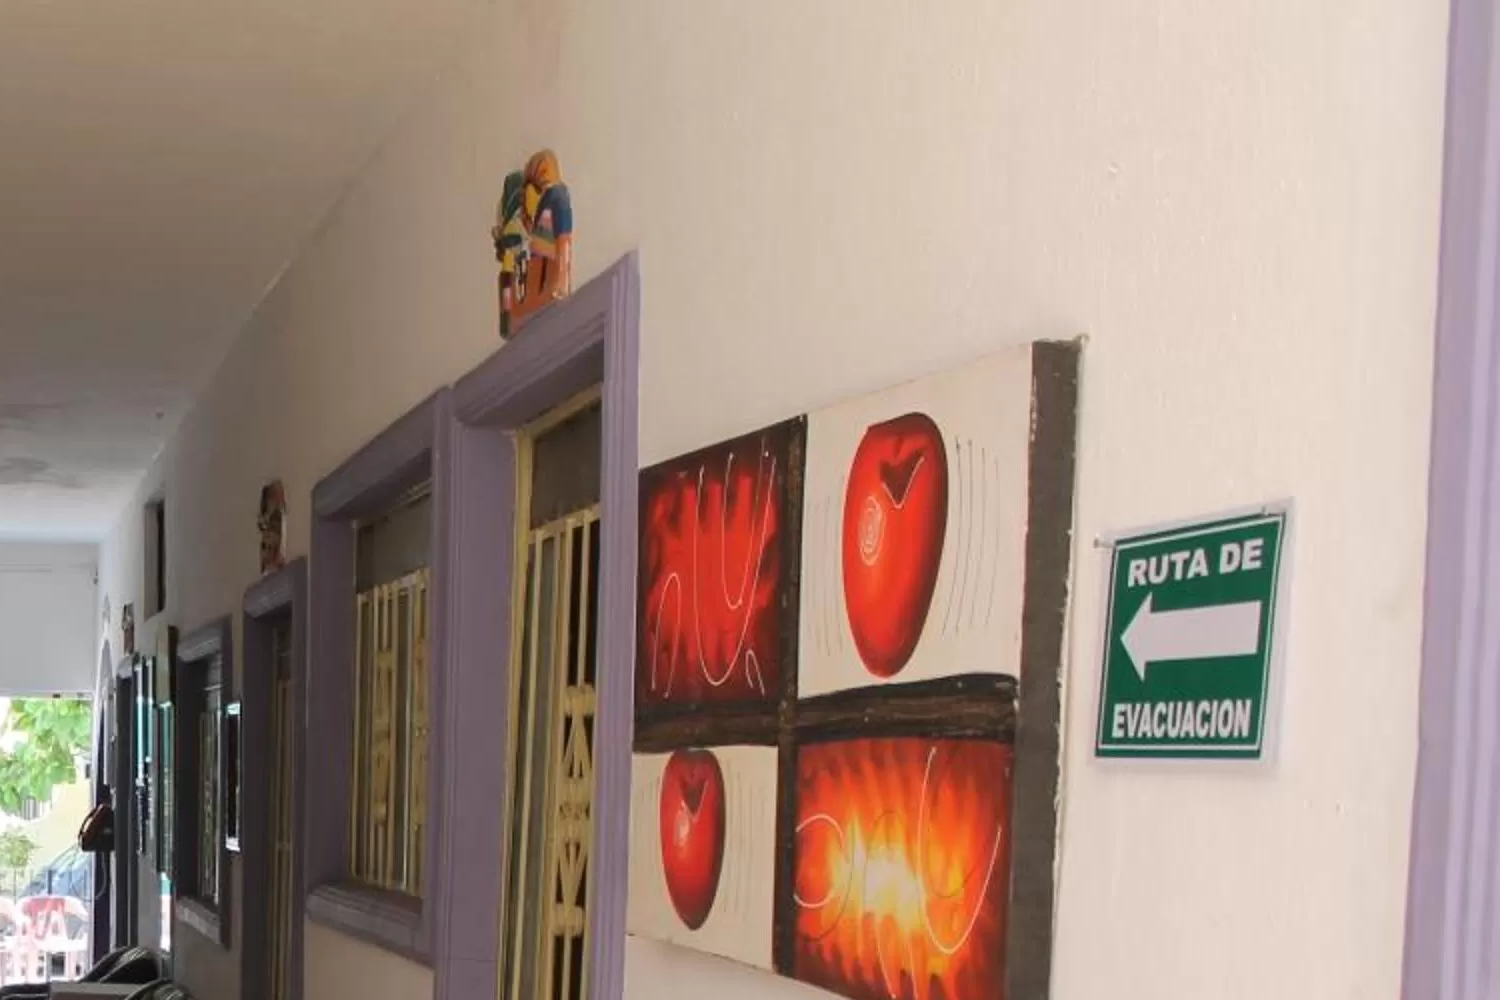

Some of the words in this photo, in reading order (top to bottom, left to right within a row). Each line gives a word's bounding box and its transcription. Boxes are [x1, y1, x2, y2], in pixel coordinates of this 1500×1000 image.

[1127, 548, 1208, 588] RUTA
[1219, 538, 1264, 574] DE
[1111, 699, 1252, 739] EVACUACION
